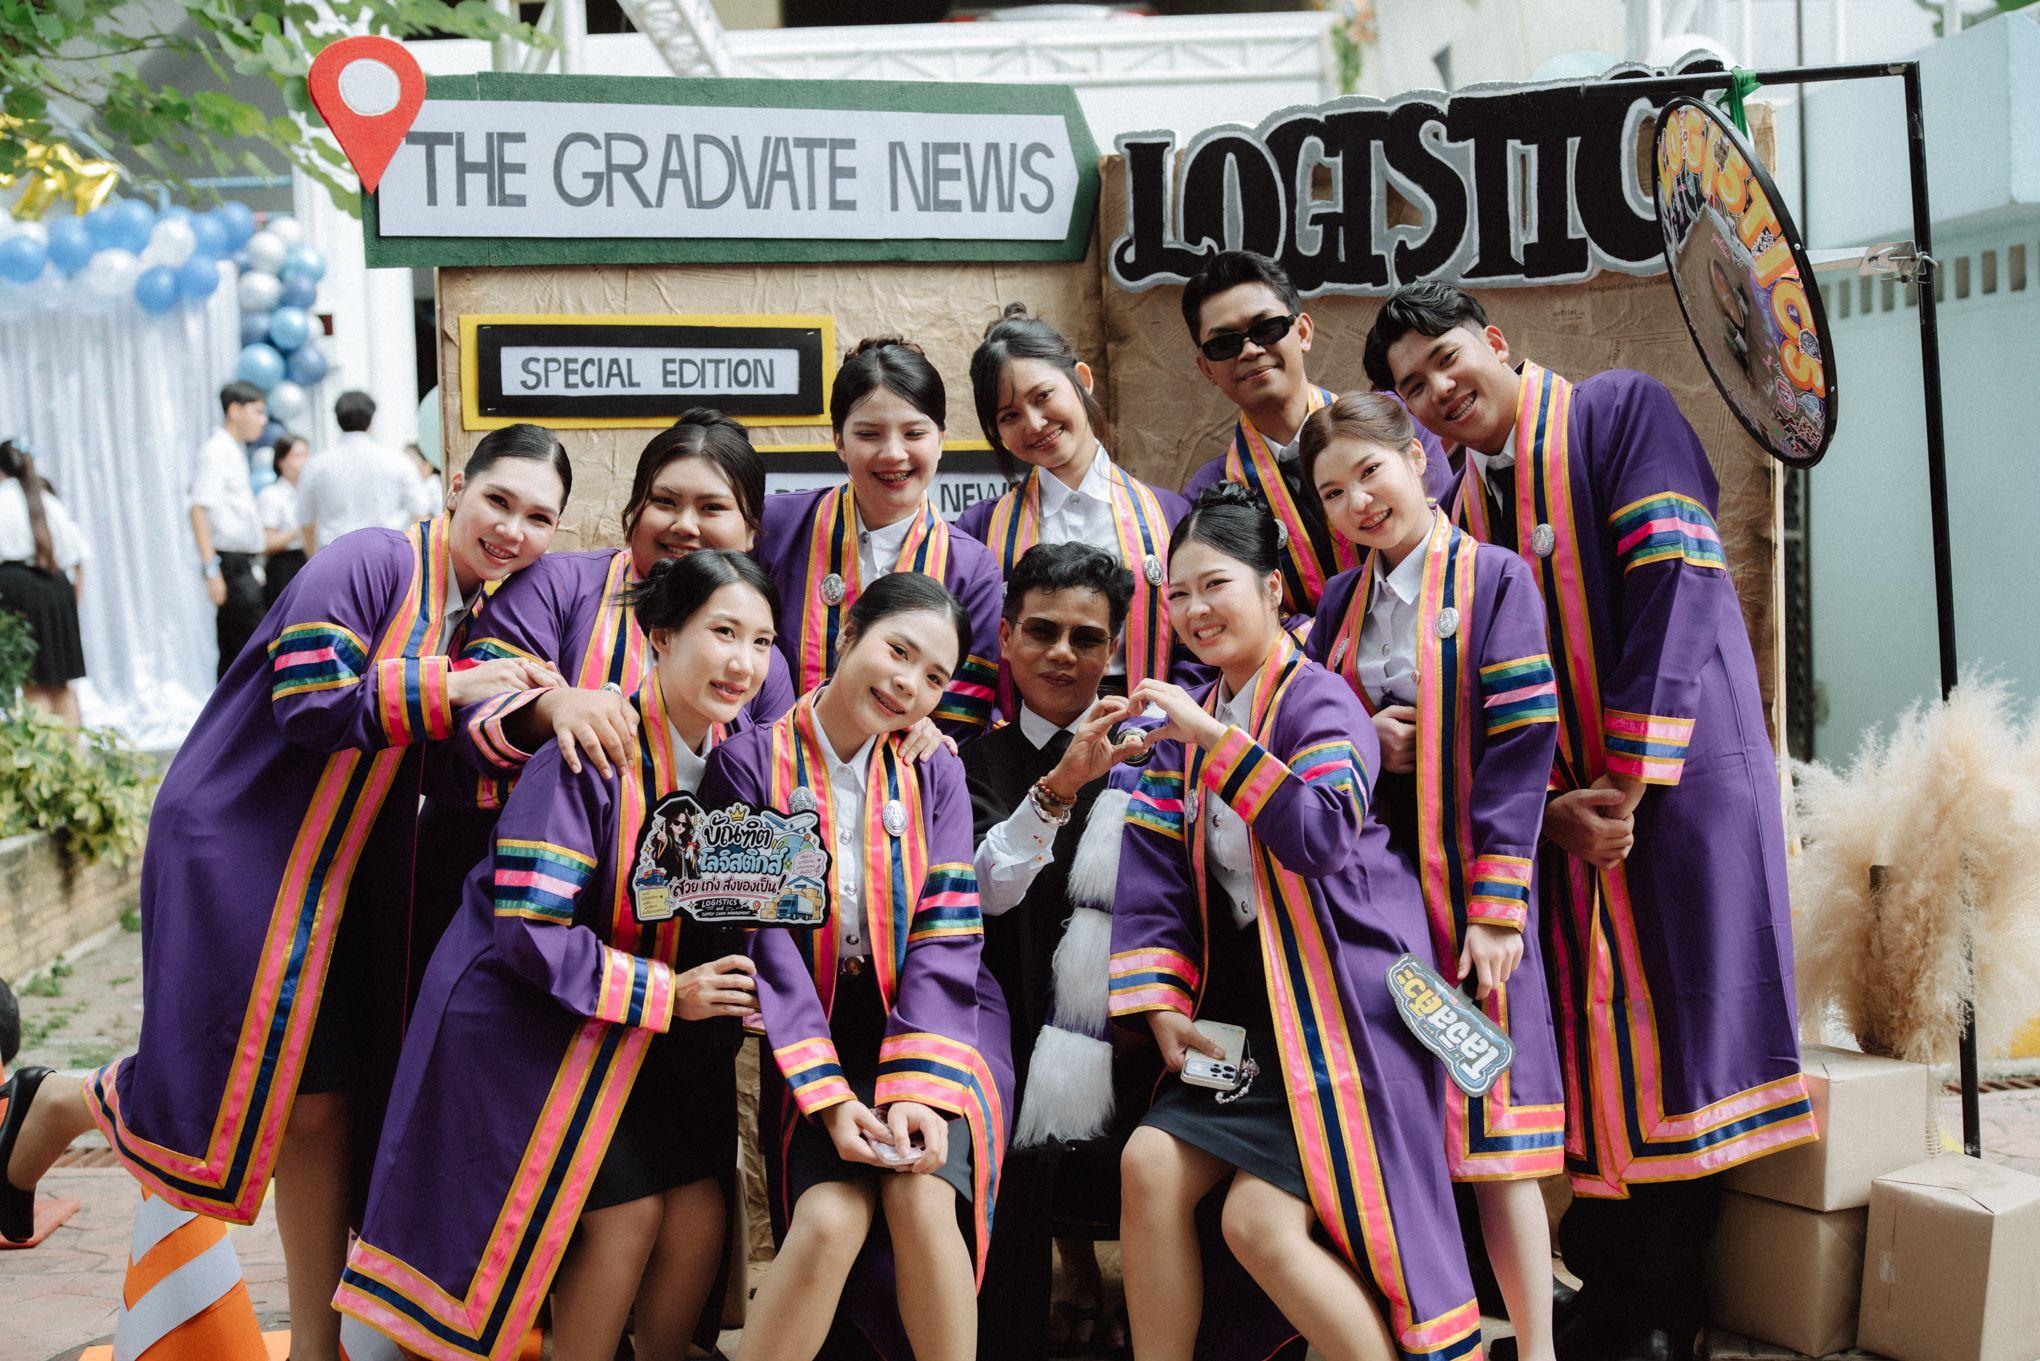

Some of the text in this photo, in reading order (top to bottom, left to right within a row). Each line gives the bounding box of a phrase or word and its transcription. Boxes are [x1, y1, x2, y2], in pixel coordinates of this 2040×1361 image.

[405, 131, 527, 207] THE
[888, 140, 1055, 214] NEWS
[520, 357, 775, 390] SPECIAL EDITION
[700, 846, 789, 876] โลจิสติกส์
[673, 879, 699, 898] สวย
[701, 899, 738, 908] LOGISTICS
